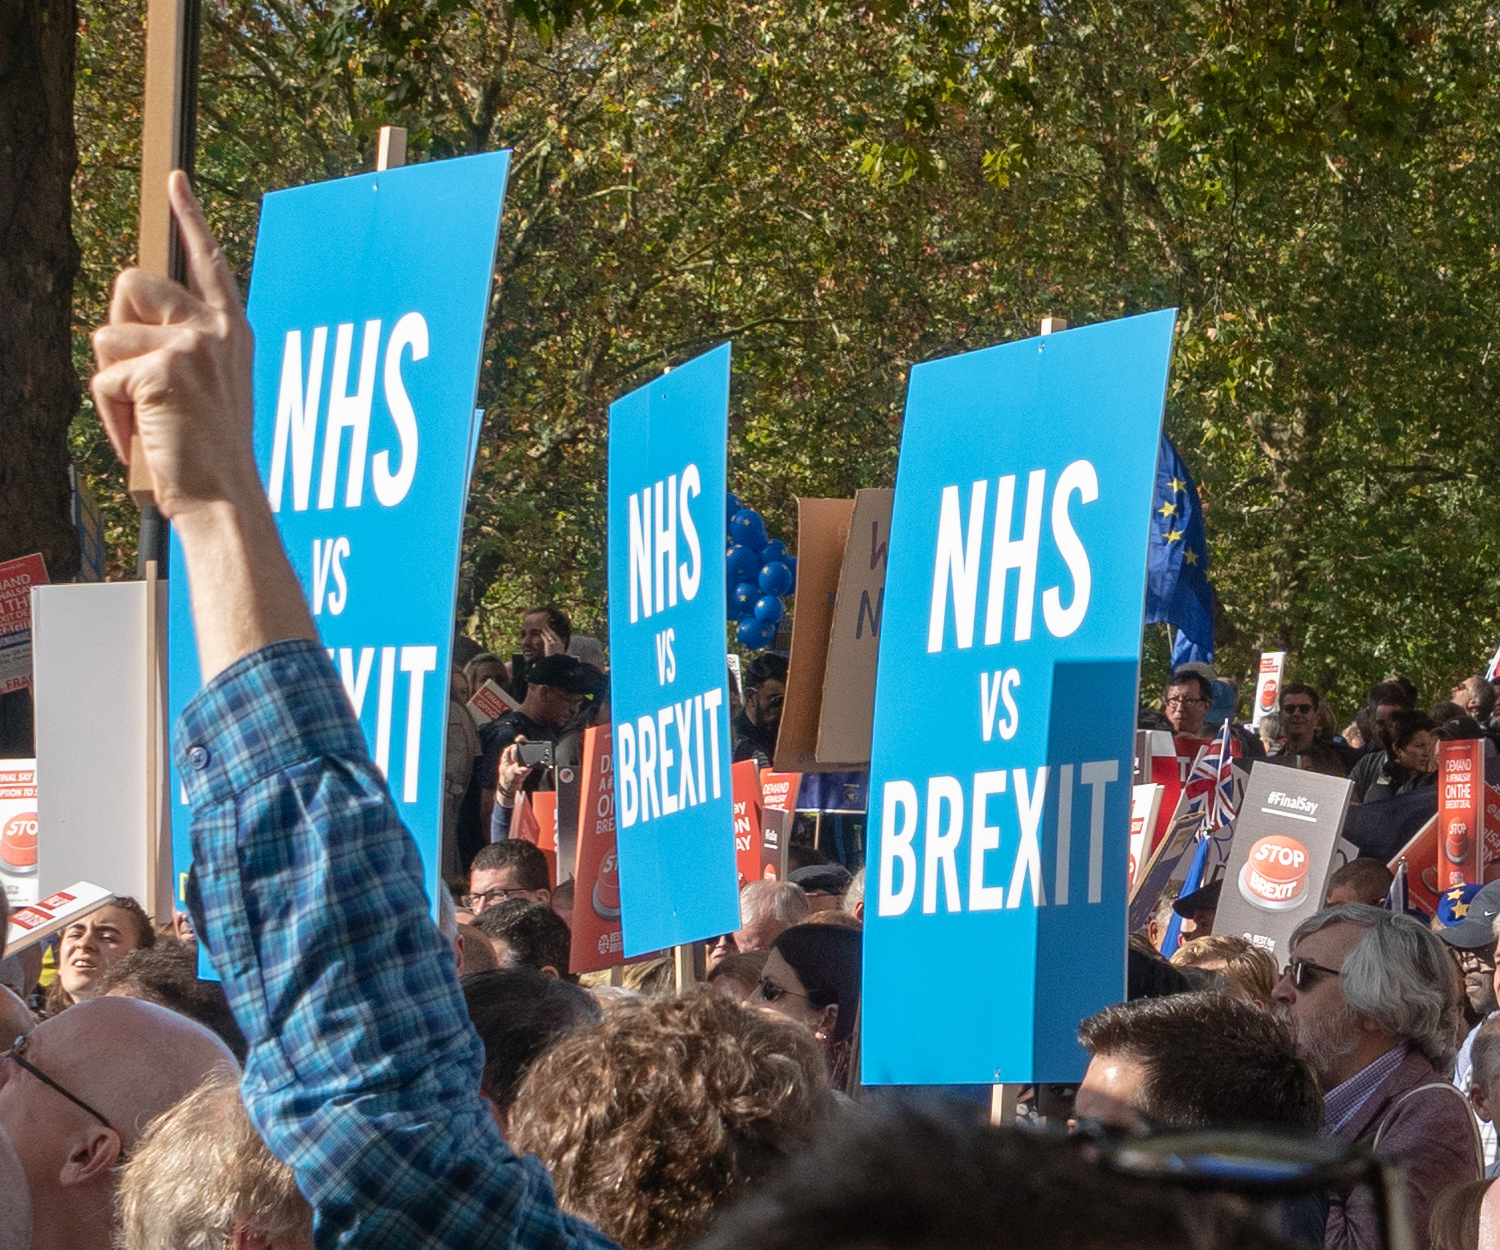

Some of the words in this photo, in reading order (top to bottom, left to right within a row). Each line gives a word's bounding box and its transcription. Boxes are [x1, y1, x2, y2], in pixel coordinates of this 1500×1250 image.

[268, 311, 431, 514] NHS
[628, 463, 702, 624] NHS
[927, 459, 1099, 654] NHS
[312, 536, 351, 617] VS
[5, 593, 31, 611] TH
[655, 628, 677, 688] VS
[979, 668, 1021, 742] VS
[617, 687, 723, 829] BREXIT
[1445, 758, 1472, 772] DEMAND
[18, 773, 33, 782] SAY
[23, 789, 34, 797] TO
[1266, 790, 1319, 815] #FinalSay
[1445, 784, 1456, 799] ON
[1456, 783, 1472, 799] THE
[6, 820, 38, 836] STO
[878, 758, 1120, 918] BREXIT
[1449, 823, 1467, 835] STOP
[1254, 843, 1305, 867] STOP
[1250, 872, 1297, 899] BREXIT
